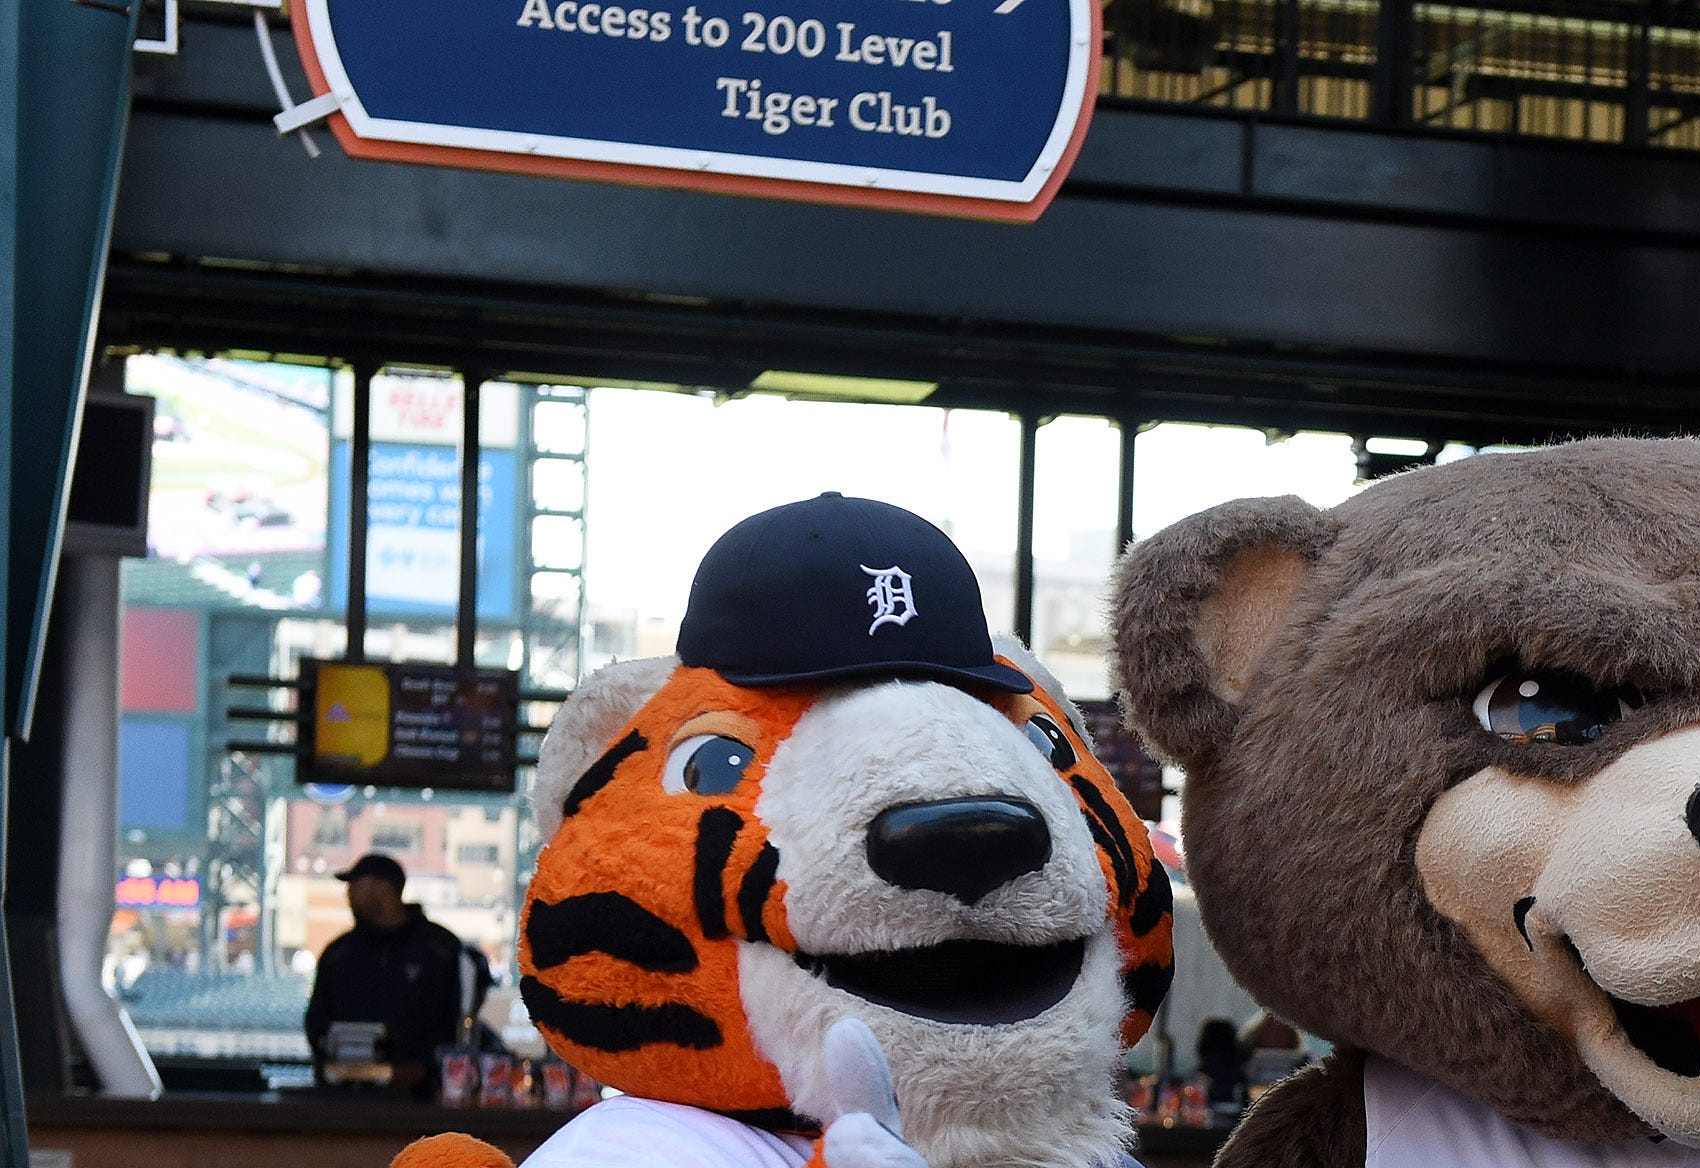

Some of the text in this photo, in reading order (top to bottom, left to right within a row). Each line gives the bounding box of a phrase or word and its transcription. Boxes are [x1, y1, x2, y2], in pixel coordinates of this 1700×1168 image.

[516, 0, 955, 73] Access to 200 Level
[716, 76, 952, 139] Tiger Club
[860, 563, 919, 636] D
